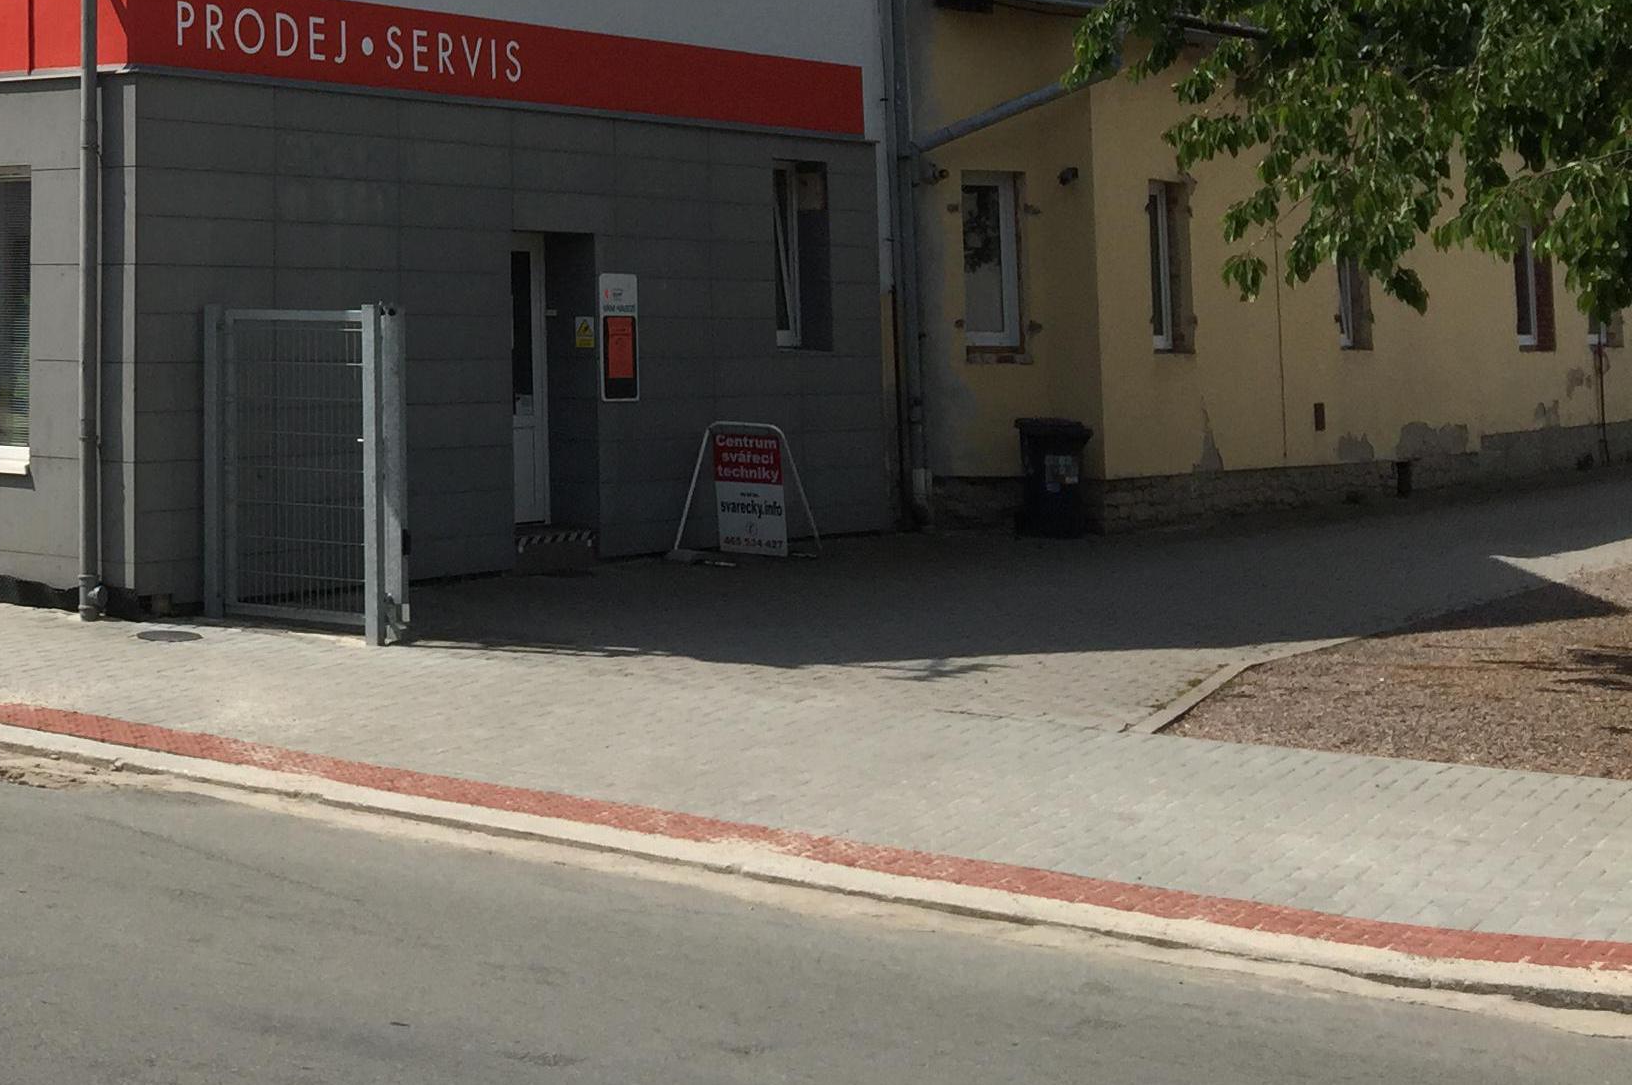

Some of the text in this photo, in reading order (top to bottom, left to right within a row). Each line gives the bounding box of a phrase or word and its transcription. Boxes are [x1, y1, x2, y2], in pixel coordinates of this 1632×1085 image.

[176, 0, 522, 83] PRODEJ SERVIS
[715, 434, 778, 450] Centrum
[718, 466, 779, 483] techniky
[721, 500, 783, 519] svarecky.info
